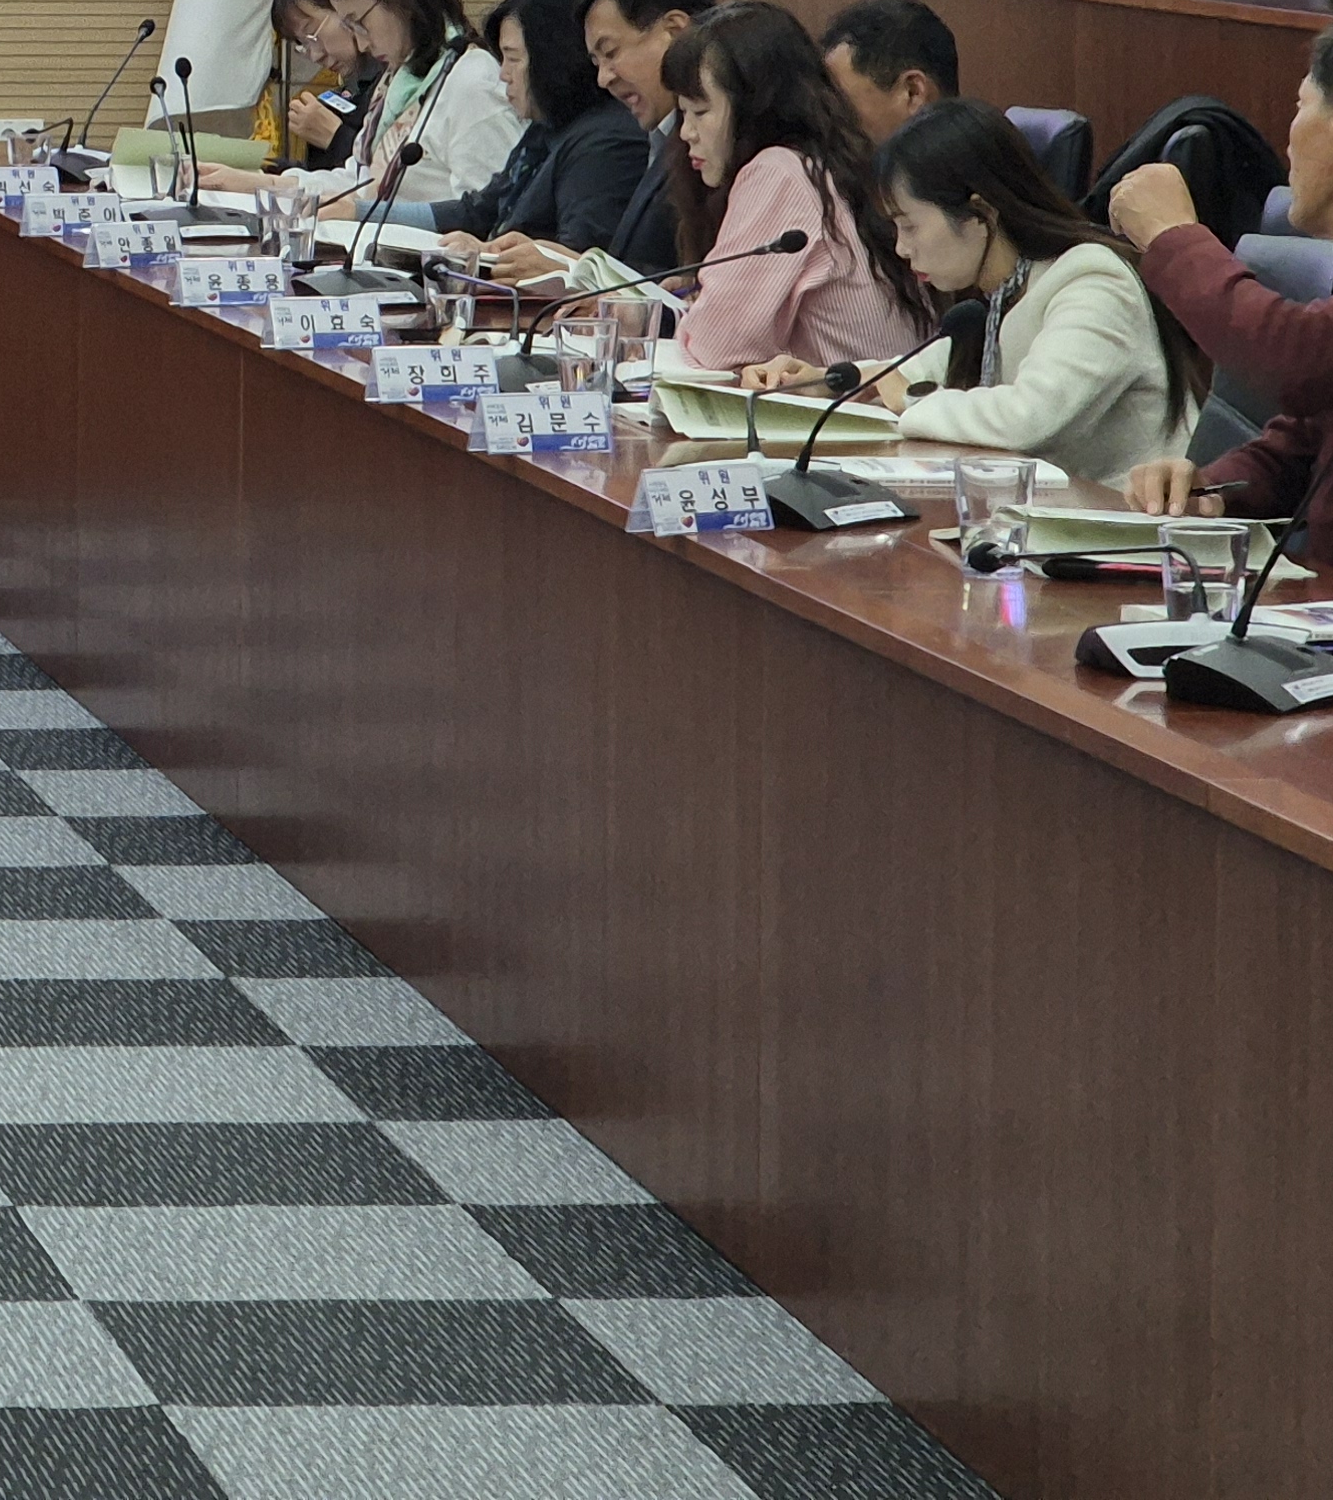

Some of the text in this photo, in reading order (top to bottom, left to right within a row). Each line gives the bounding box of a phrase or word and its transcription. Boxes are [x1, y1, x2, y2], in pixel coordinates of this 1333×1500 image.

[538, 394, 572, 411] 위원
[514, 411, 601, 434] 김문수
[697, 468, 731, 486] 위원
[678, 485, 761, 514] 윤성부
